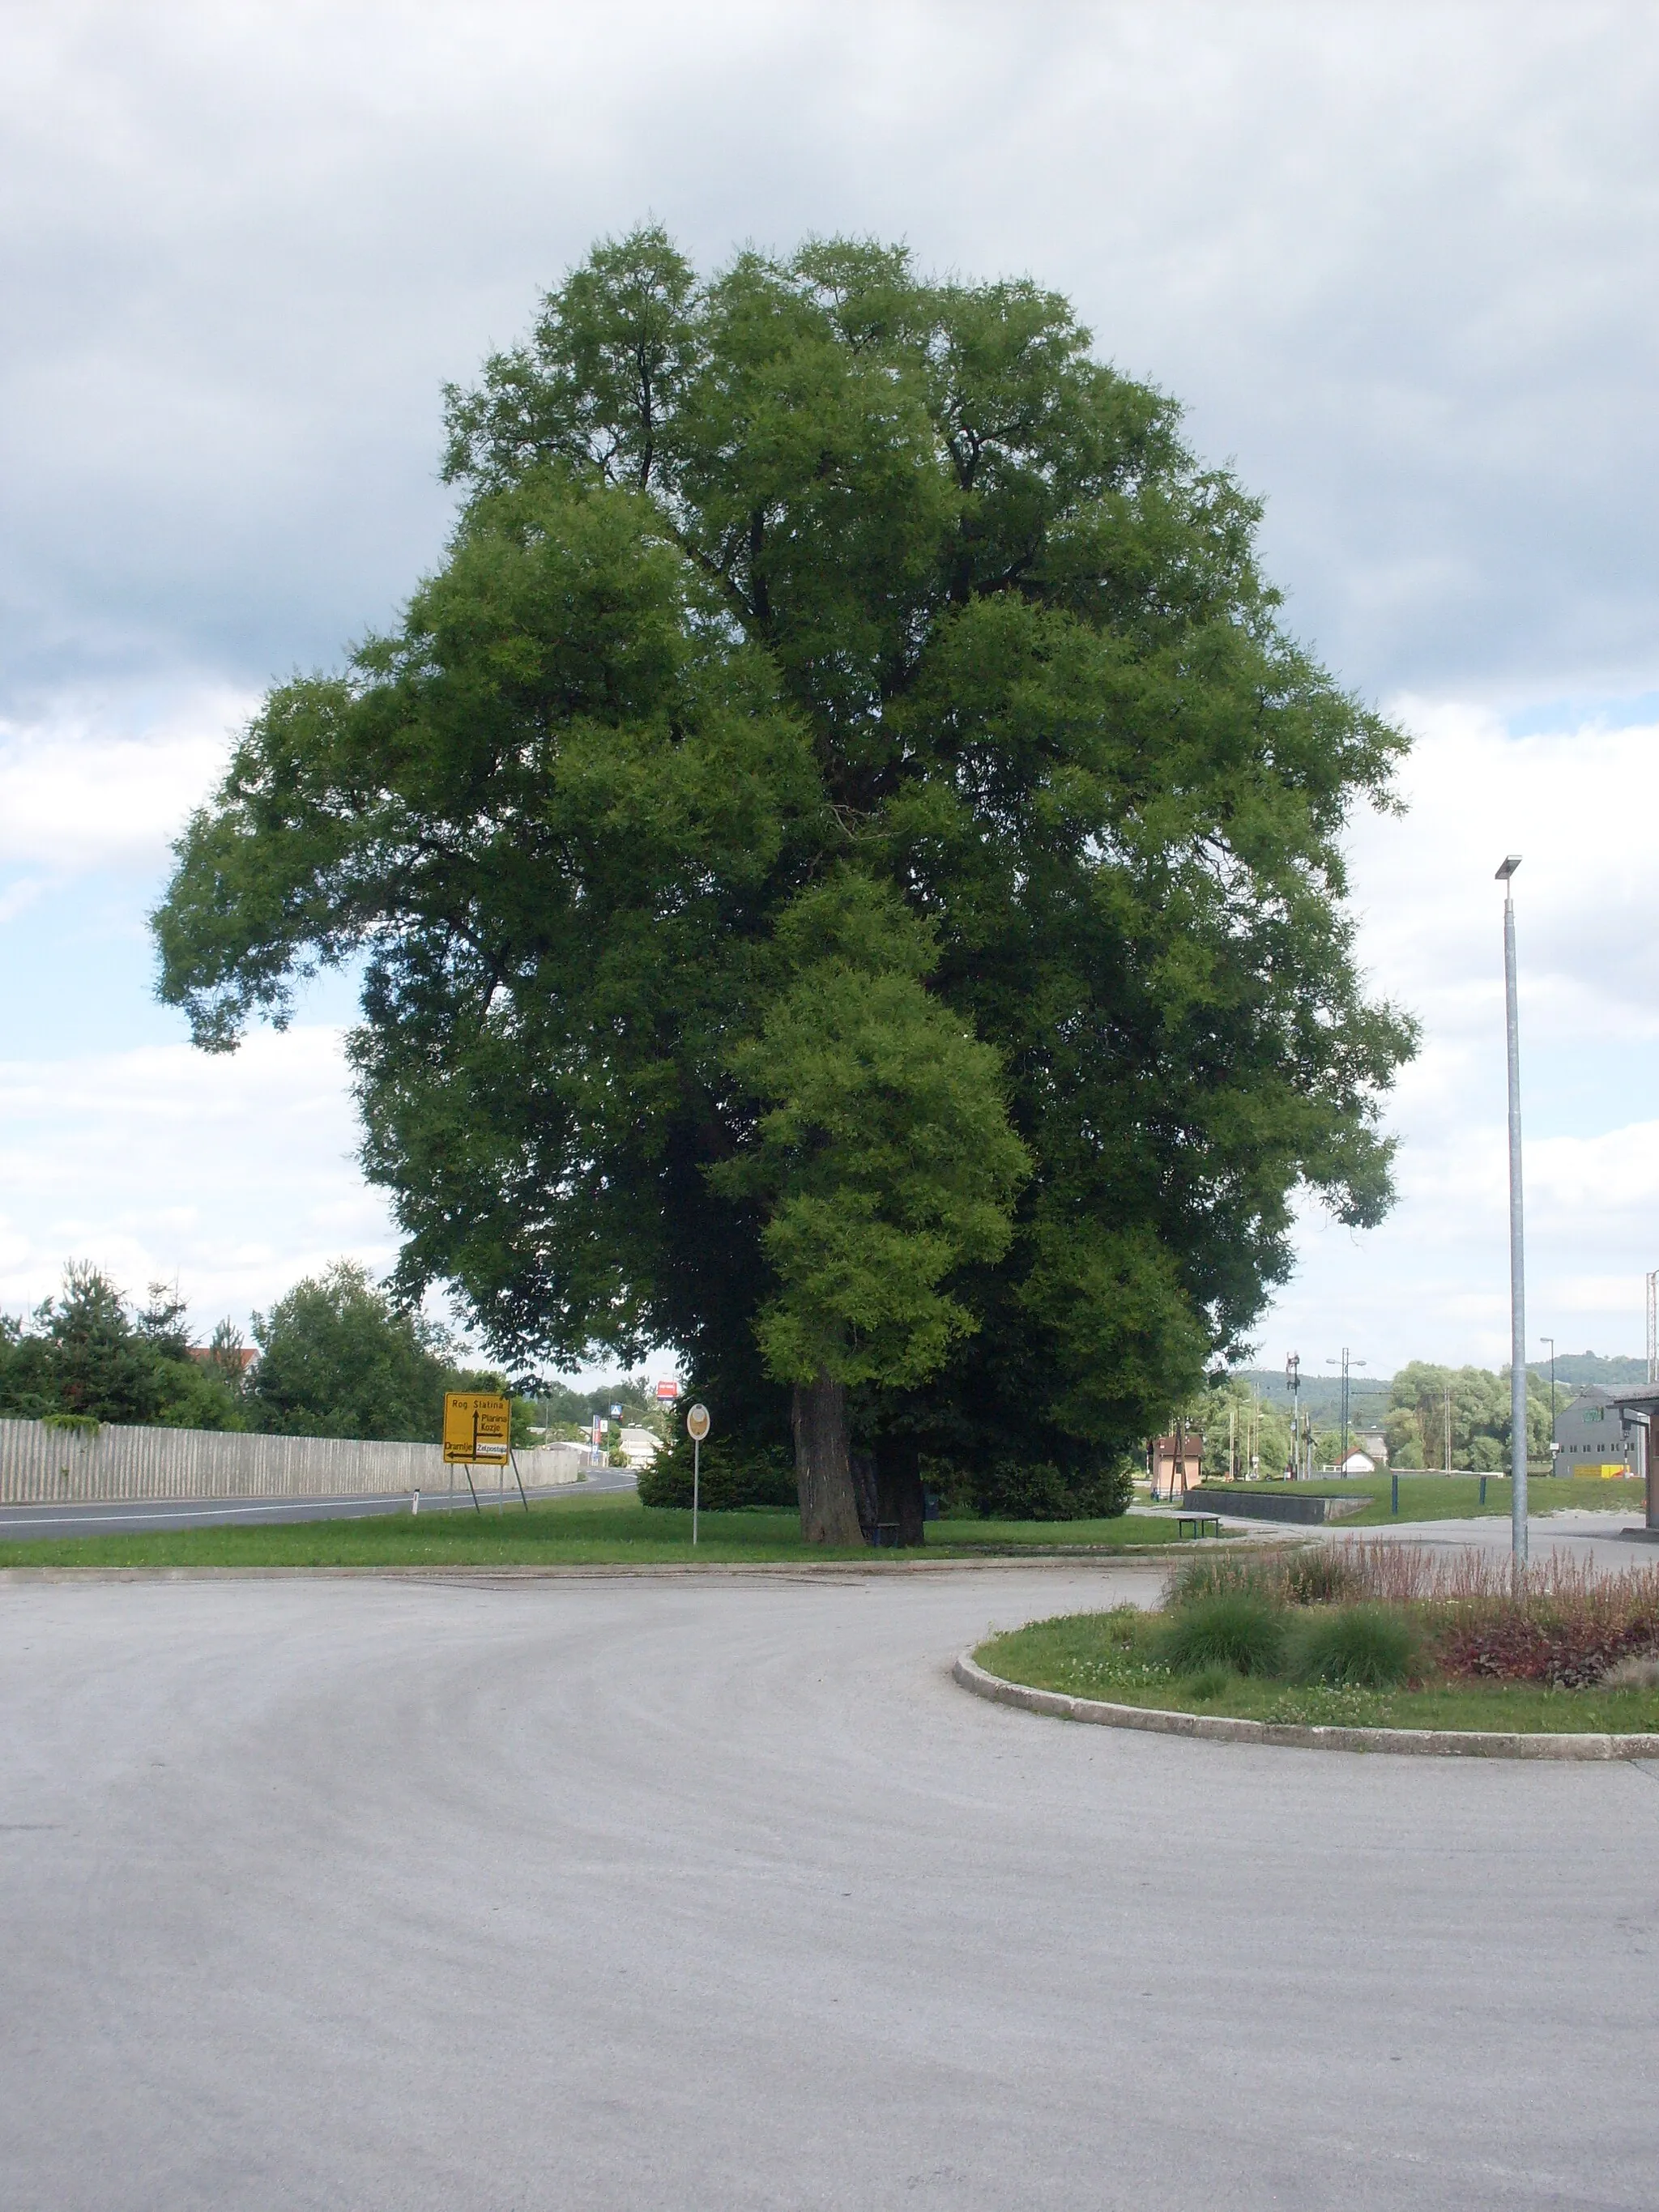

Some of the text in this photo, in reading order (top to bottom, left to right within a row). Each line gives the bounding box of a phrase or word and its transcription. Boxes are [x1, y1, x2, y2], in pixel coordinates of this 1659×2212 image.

[474, 1400, 503, 1409] Slatina
[481, 1414, 507, 1423] Planina
[481, 1423, 500, 1432] Kozje
[445, 1442, 472, 1452] Dramlje
